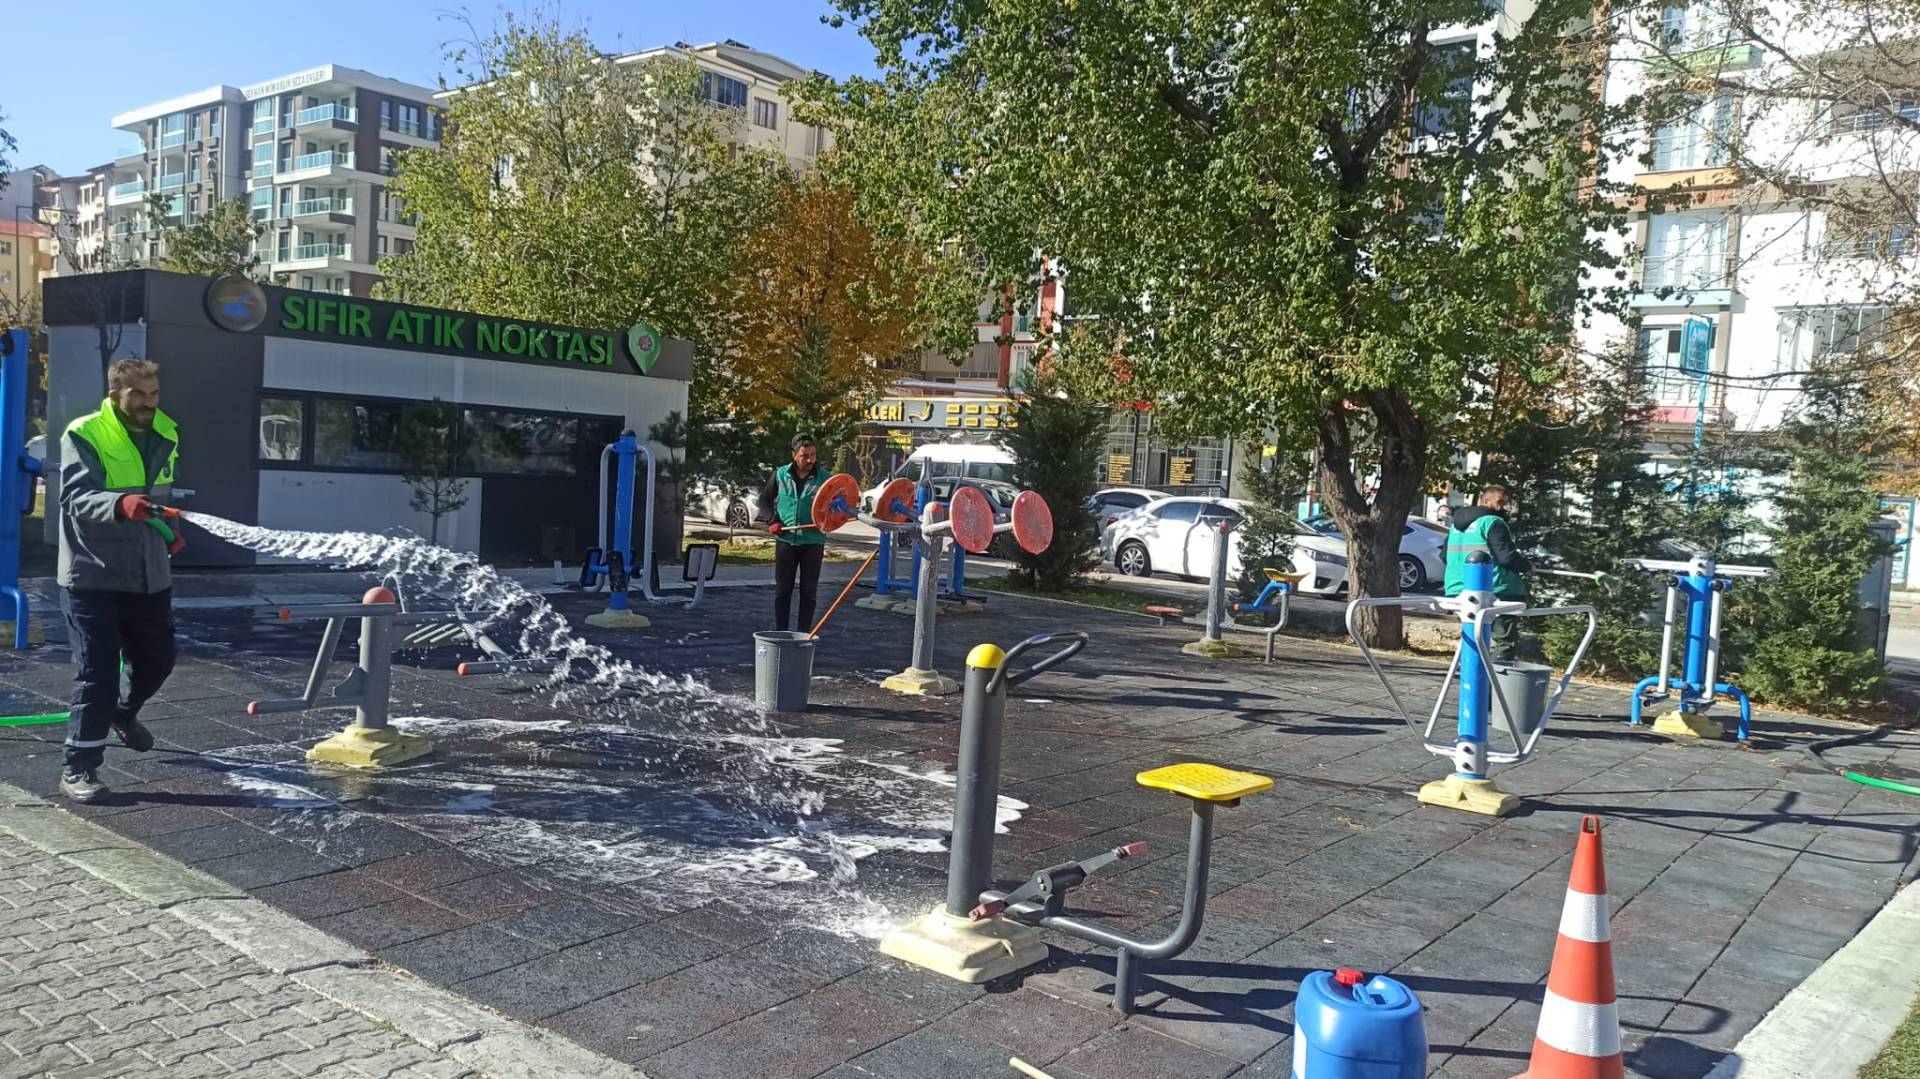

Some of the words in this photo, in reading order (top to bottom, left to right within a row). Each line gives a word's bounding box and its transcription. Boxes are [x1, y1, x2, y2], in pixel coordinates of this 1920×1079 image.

[282, 295, 373, 338] SIFIR
[386, 309, 465, 349] ATIK
[477, 320, 614, 366] NOKTASI
